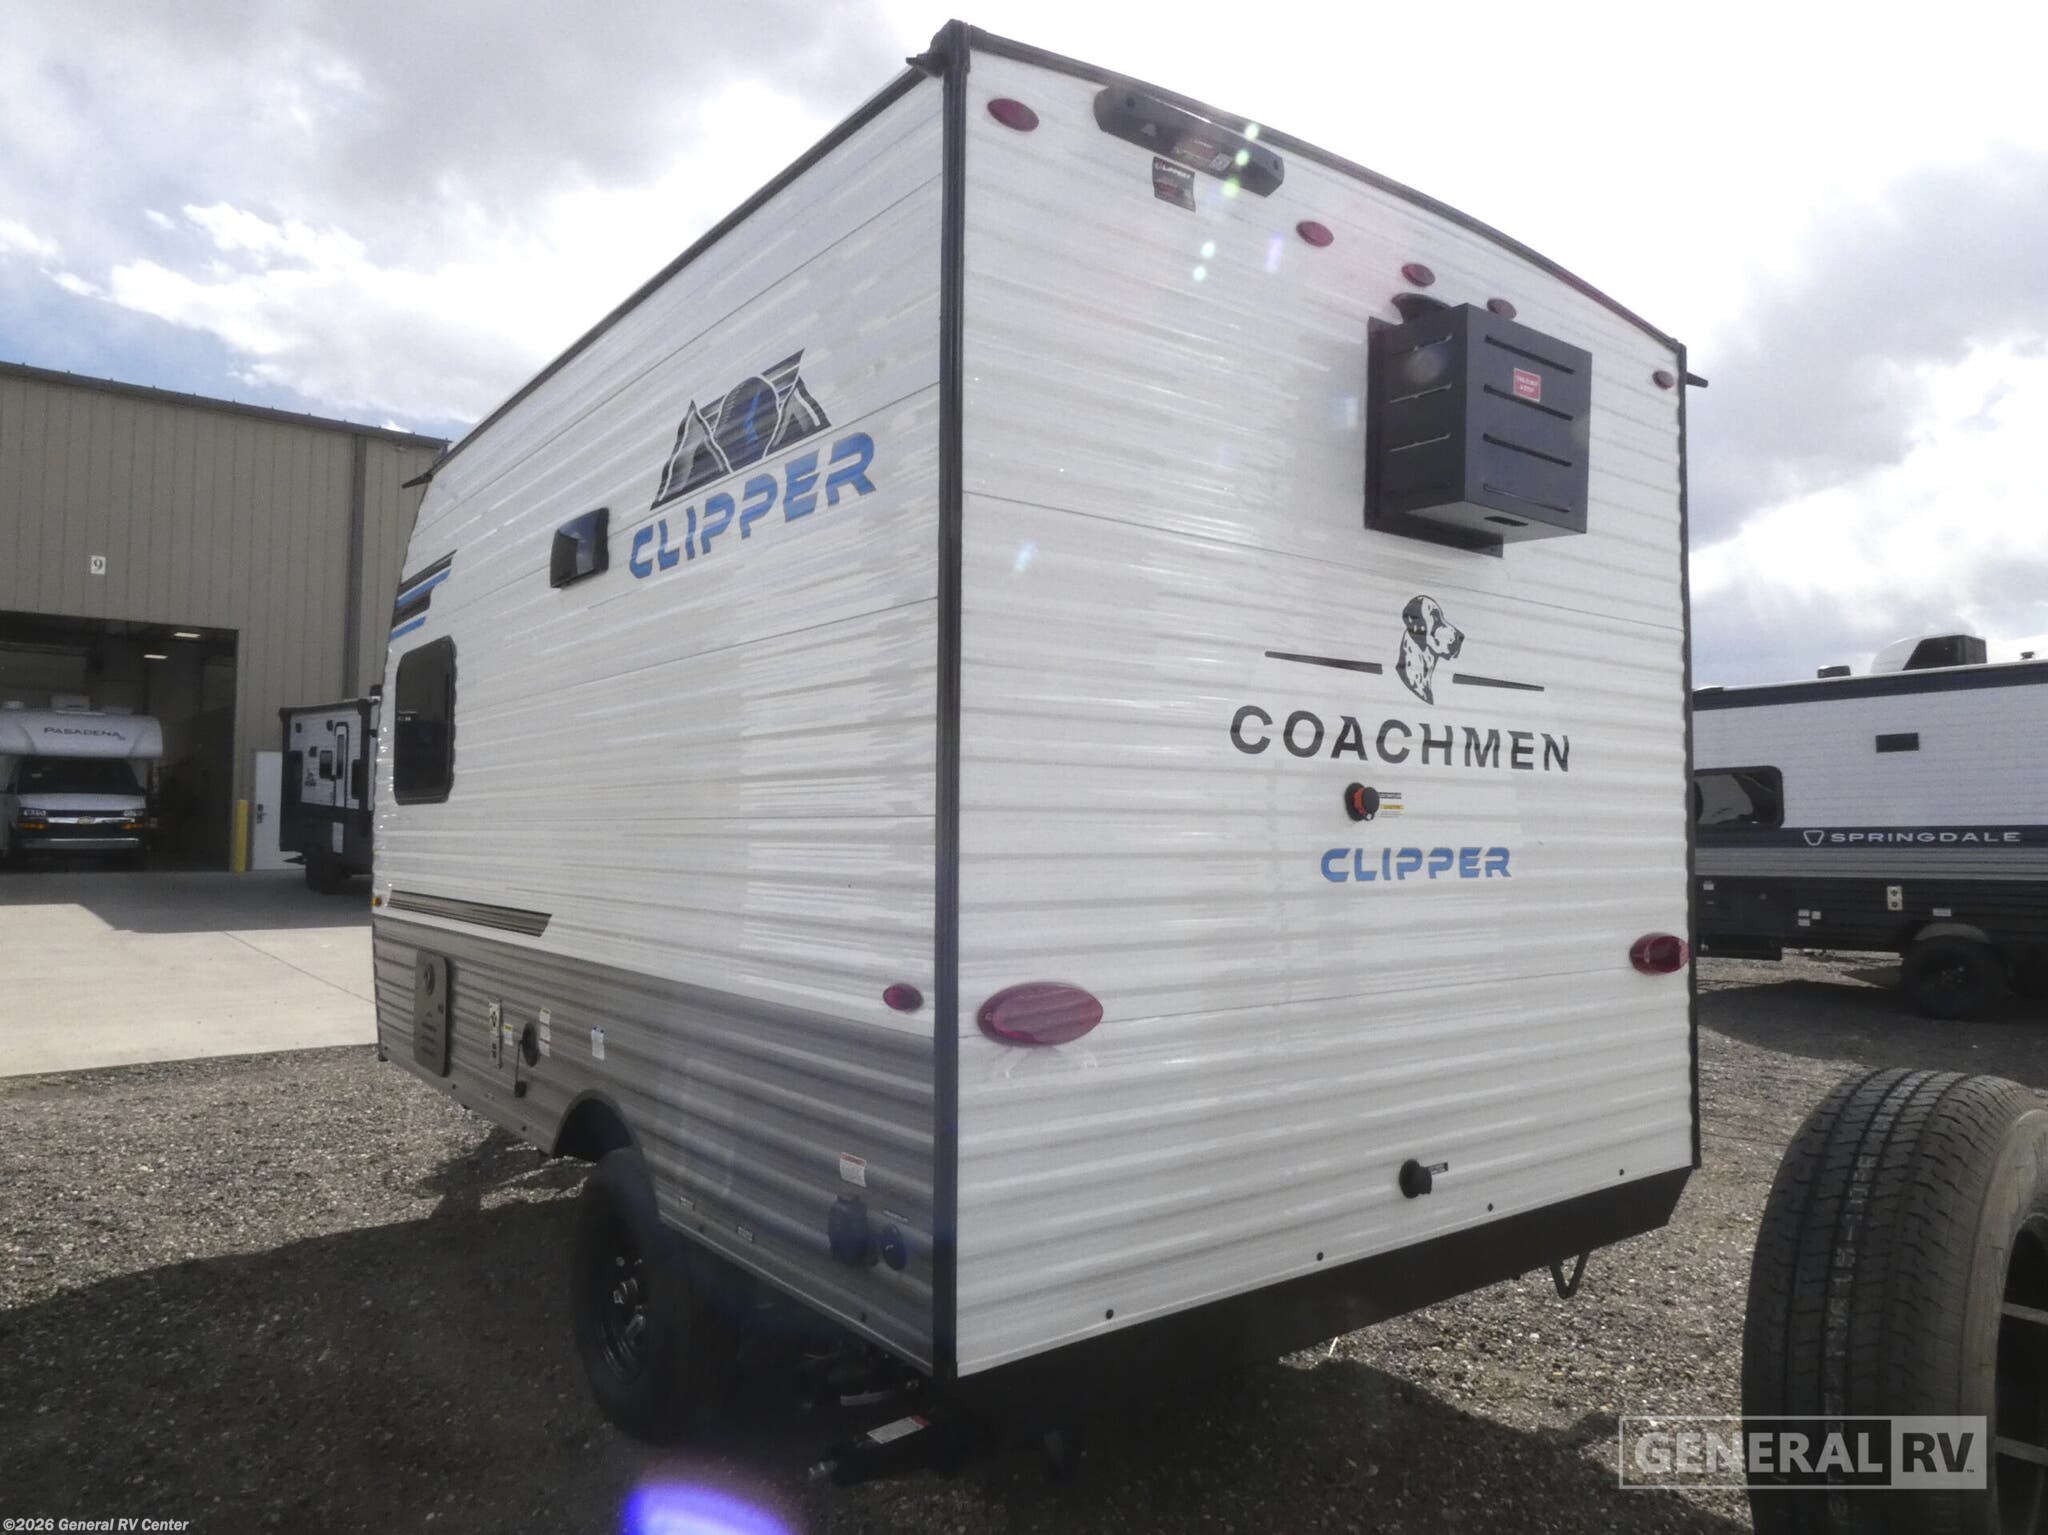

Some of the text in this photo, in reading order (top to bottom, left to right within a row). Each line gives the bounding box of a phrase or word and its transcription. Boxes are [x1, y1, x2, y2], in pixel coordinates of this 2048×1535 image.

[629, 431, 877, 579] CLIPPER
[93, 558, 104, 571] 9
[44, 726, 120, 738] PASADENA
[1230, 705, 1570, 772] COACHMEN
[1830, 831, 2022, 843] SPRINGDALE
[1321, 847, 1512, 883] CLIPPER
